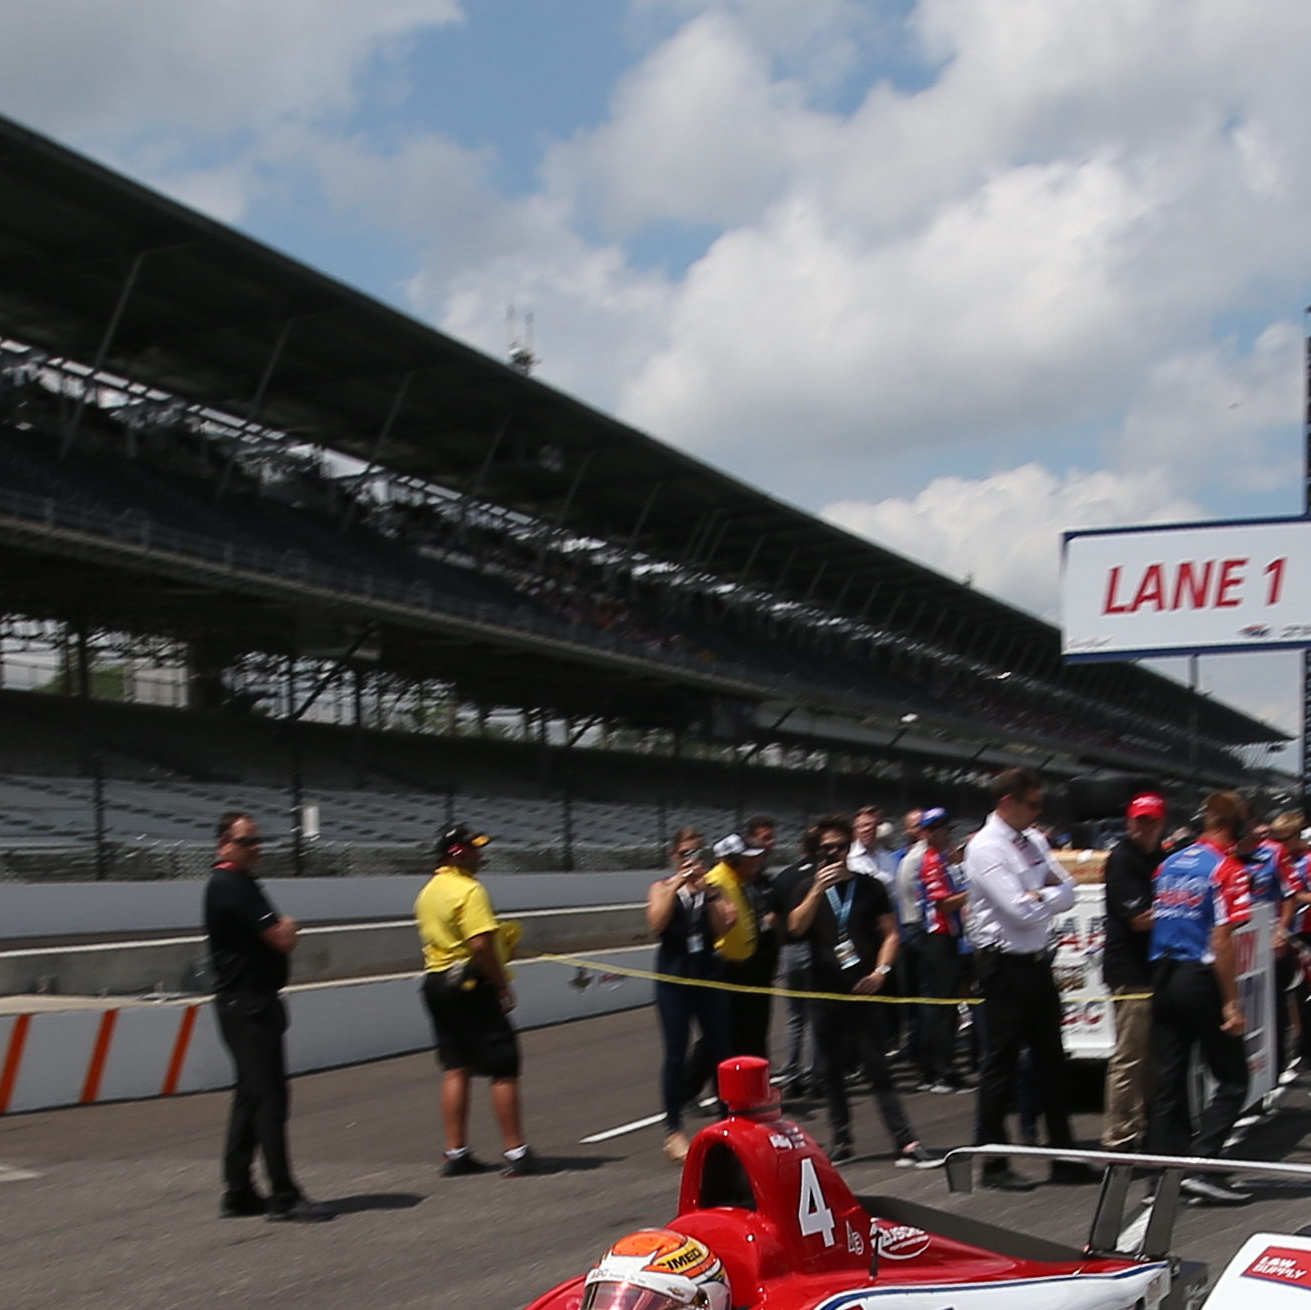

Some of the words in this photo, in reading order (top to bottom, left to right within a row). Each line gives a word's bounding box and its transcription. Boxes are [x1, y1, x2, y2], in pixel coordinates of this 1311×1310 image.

[1101, 557, 1251, 616] LANE
[1262, 555, 1288, 607] 1
[799, 1157, 835, 1247] 4
